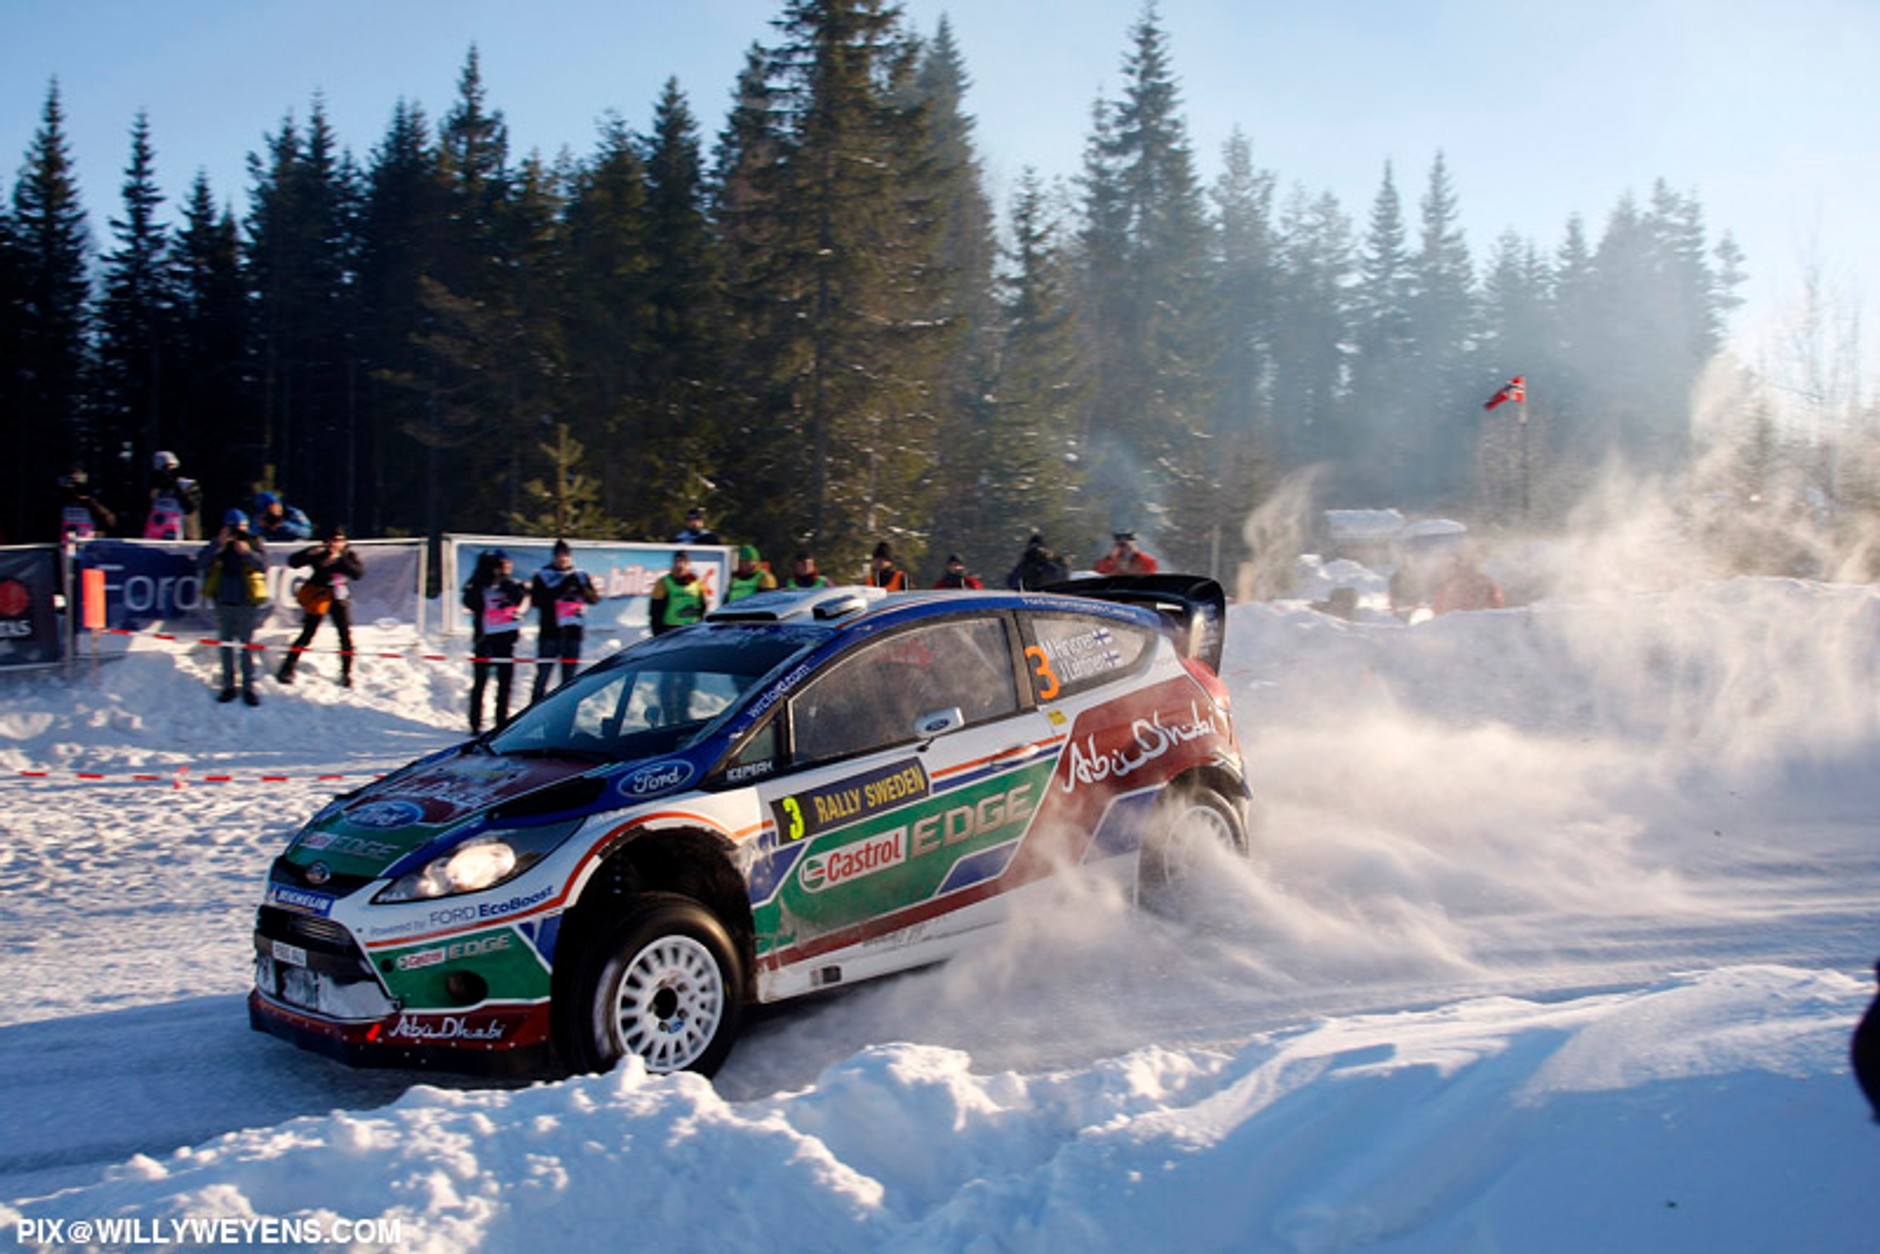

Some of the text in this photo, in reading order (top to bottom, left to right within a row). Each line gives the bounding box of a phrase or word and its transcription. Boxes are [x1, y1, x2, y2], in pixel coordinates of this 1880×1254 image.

[1024, 645, 1059, 699] 3
[633, 766, 681, 793] Ford
[813, 764, 925, 824] RALLY SWEDEN
[782, 796, 806, 840] 3
[910, 783, 1033, 858] EDGE
[826, 832, 902, 882] Castrol
[429, 905, 477, 926] FORD
[478, 884, 554, 918] EcoBoost
[448, 933, 513, 959] EDGE
